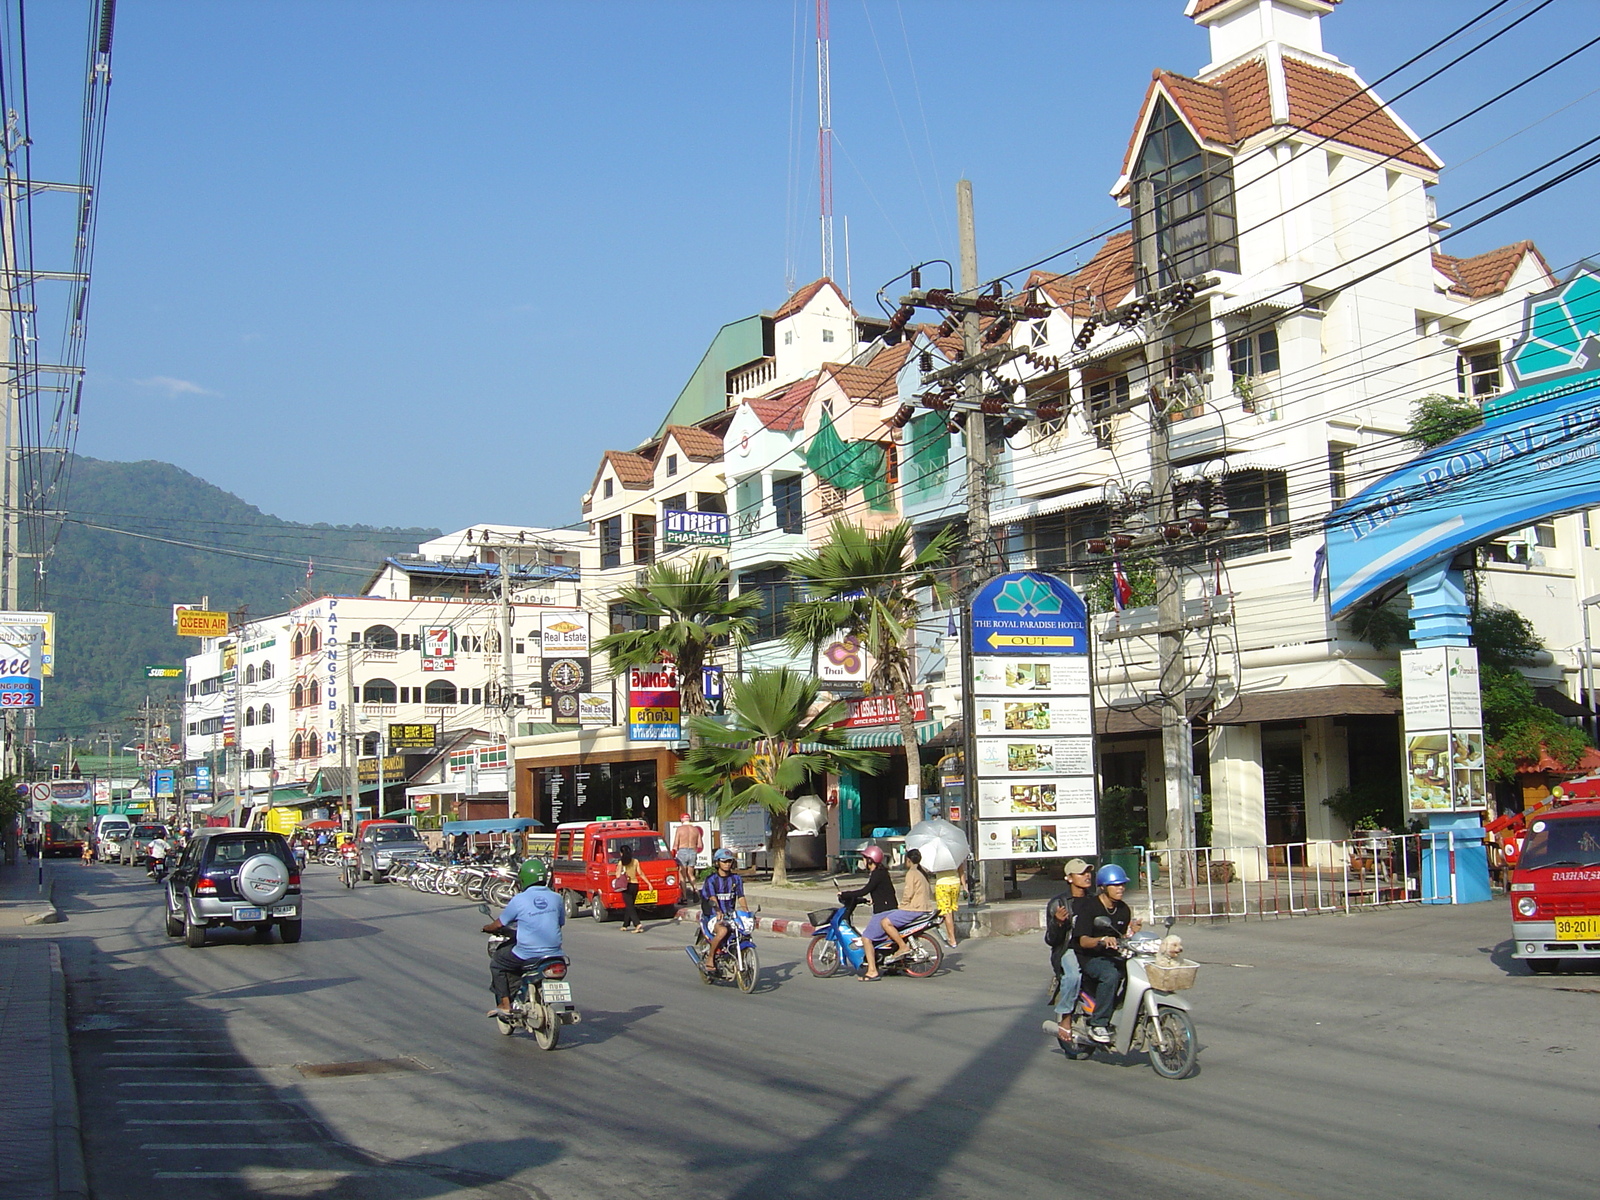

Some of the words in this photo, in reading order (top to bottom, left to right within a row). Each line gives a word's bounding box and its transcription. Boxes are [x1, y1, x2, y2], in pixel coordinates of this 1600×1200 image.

[1419, 420, 1548, 498] ROYAL
[667, 532, 726, 545] PHARMACY
[180, 617, 209, 629] QUEEN
[212, 618, 226, 630] AIR
[974, 620, 992, 628] THE
[993, 620, 1018, 629] ROYAL
[1020, 620, 1057, 629] PARADISE
[1058, 621, 1085, 629] HOTEL
[544, 632, 561, 642] Real
[563, 632, 587, 642] Estate
[1011, 636, 1048, 645] OUT
[327, 600, 338, 710] PATONGSUB
[434, 661, 444, 669] 24
[824, 666, 844, 675] Thai
[148, 668, 183, 677] SUBWAY
[2, 692, 35, 705] 522
[580, 705, 593, 713] Real
[594, 705, 611, 713] Estate
[327, 717, 337, 754] INN
[404, 725, 420, 738] BIKE
[1552, 870, 1600, 881] DAIHATS
